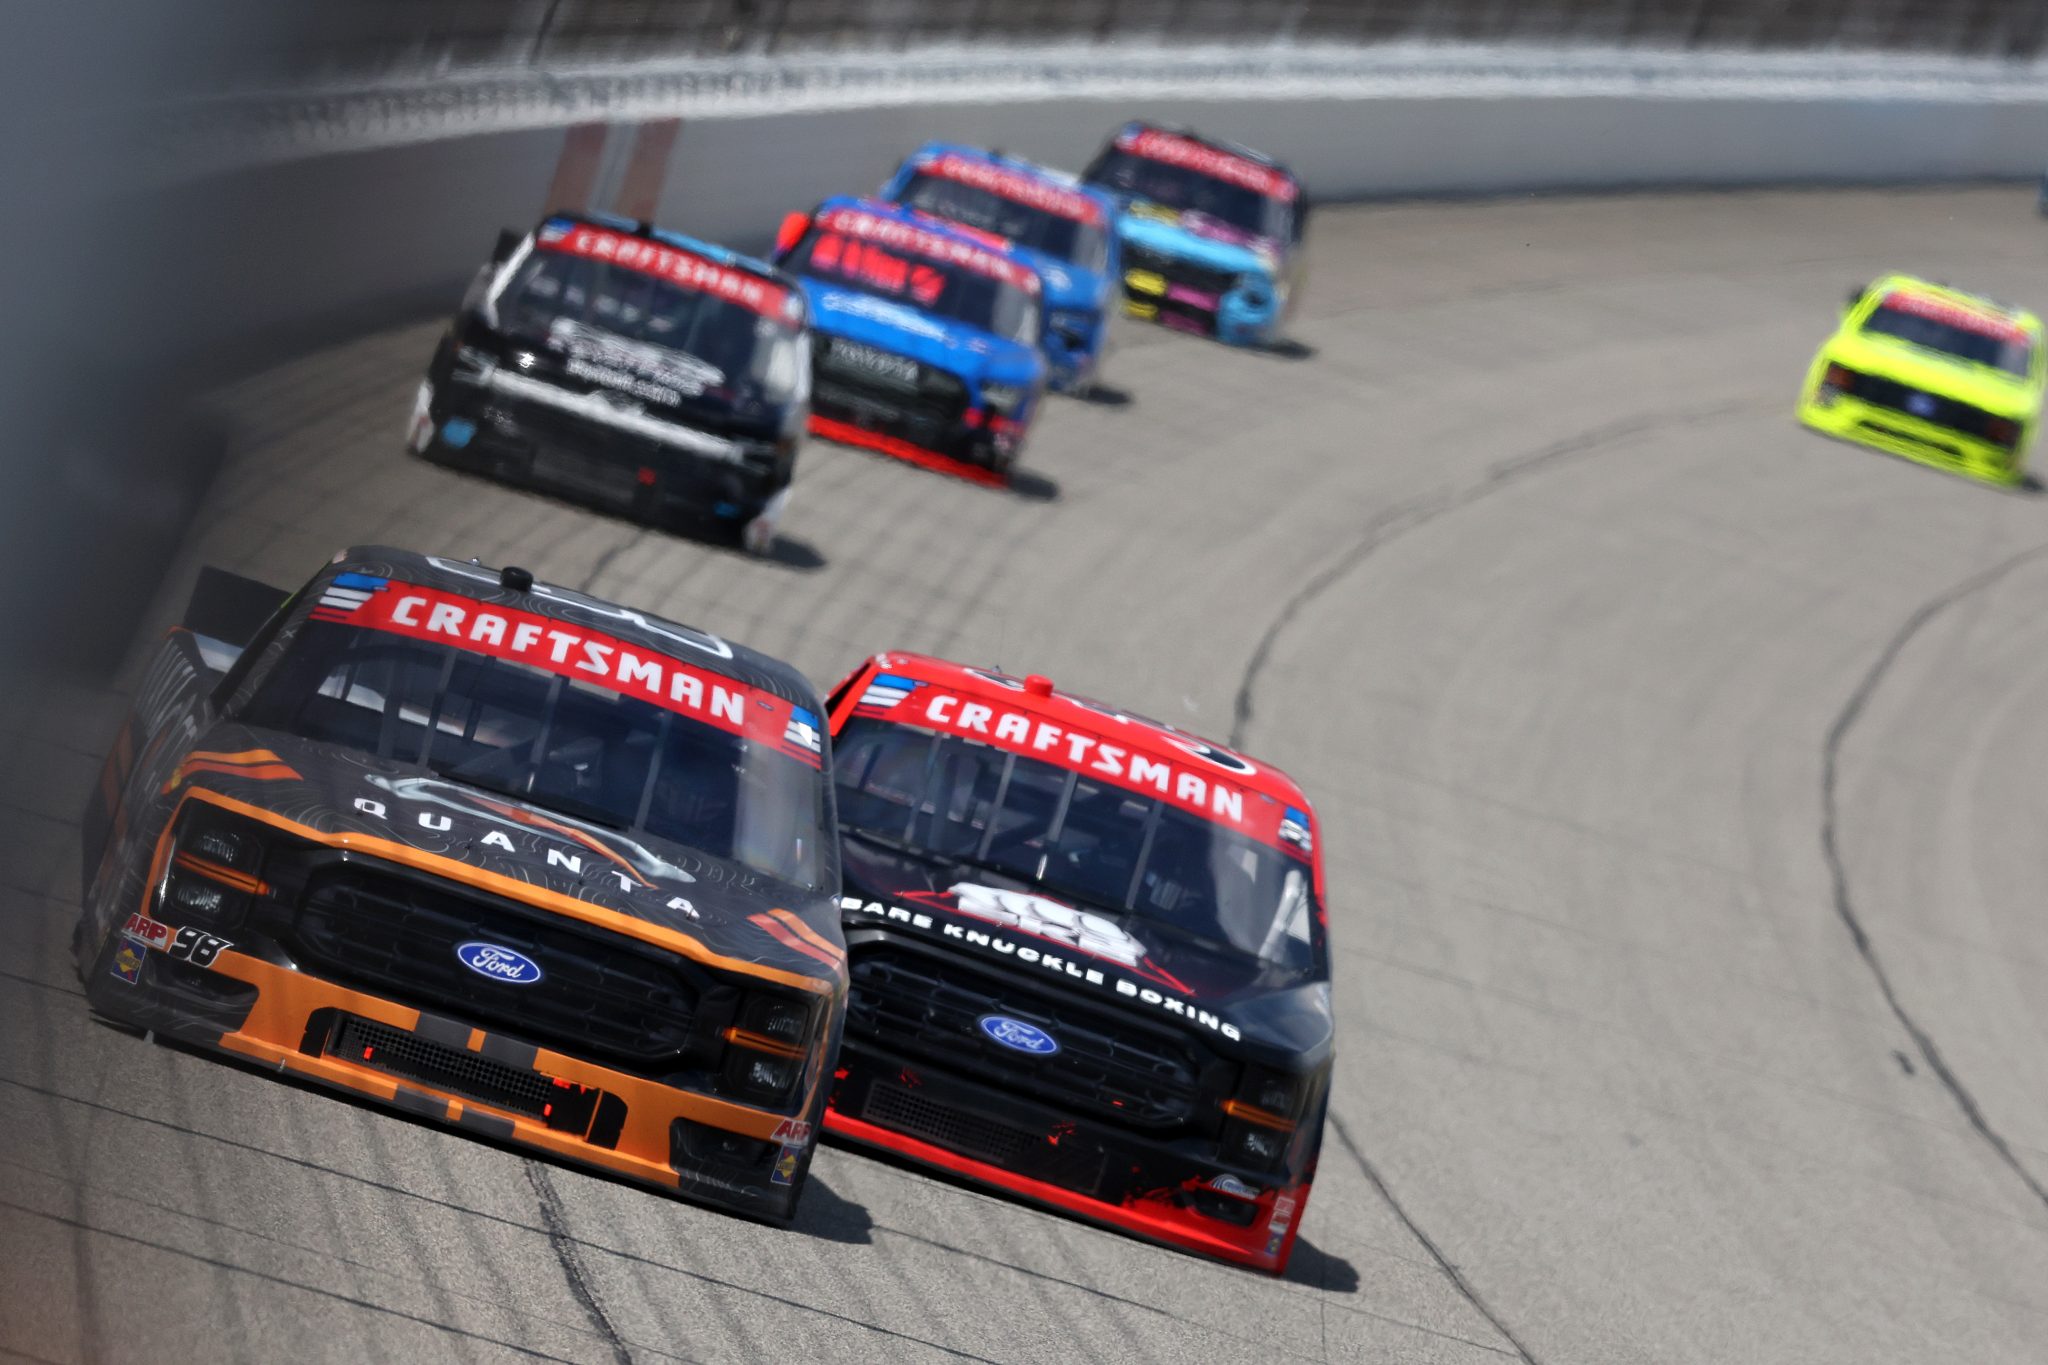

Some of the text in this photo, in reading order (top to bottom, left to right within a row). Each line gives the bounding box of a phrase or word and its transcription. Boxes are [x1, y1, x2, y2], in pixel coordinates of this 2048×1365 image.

[575, 231, 763, 303] CRAFTSMAN
[390, 596, 745, 726] CRAFTSMAN
[925, 695, 1243, 822] CRAFTSMAN
[354, 797, 701, 919] QUANTA
[124, 914, 168, 942] ARP
[167, 926, 234, 968] 98
[473, 945, 525, 978] Ford
[840, 897, 933, 930] BARE
[943, 922, 1105, 985] KNUCKLE
[1116, 978, 1241, 1041] BOXING
[994, 1020, 1044, 1050] Ford
